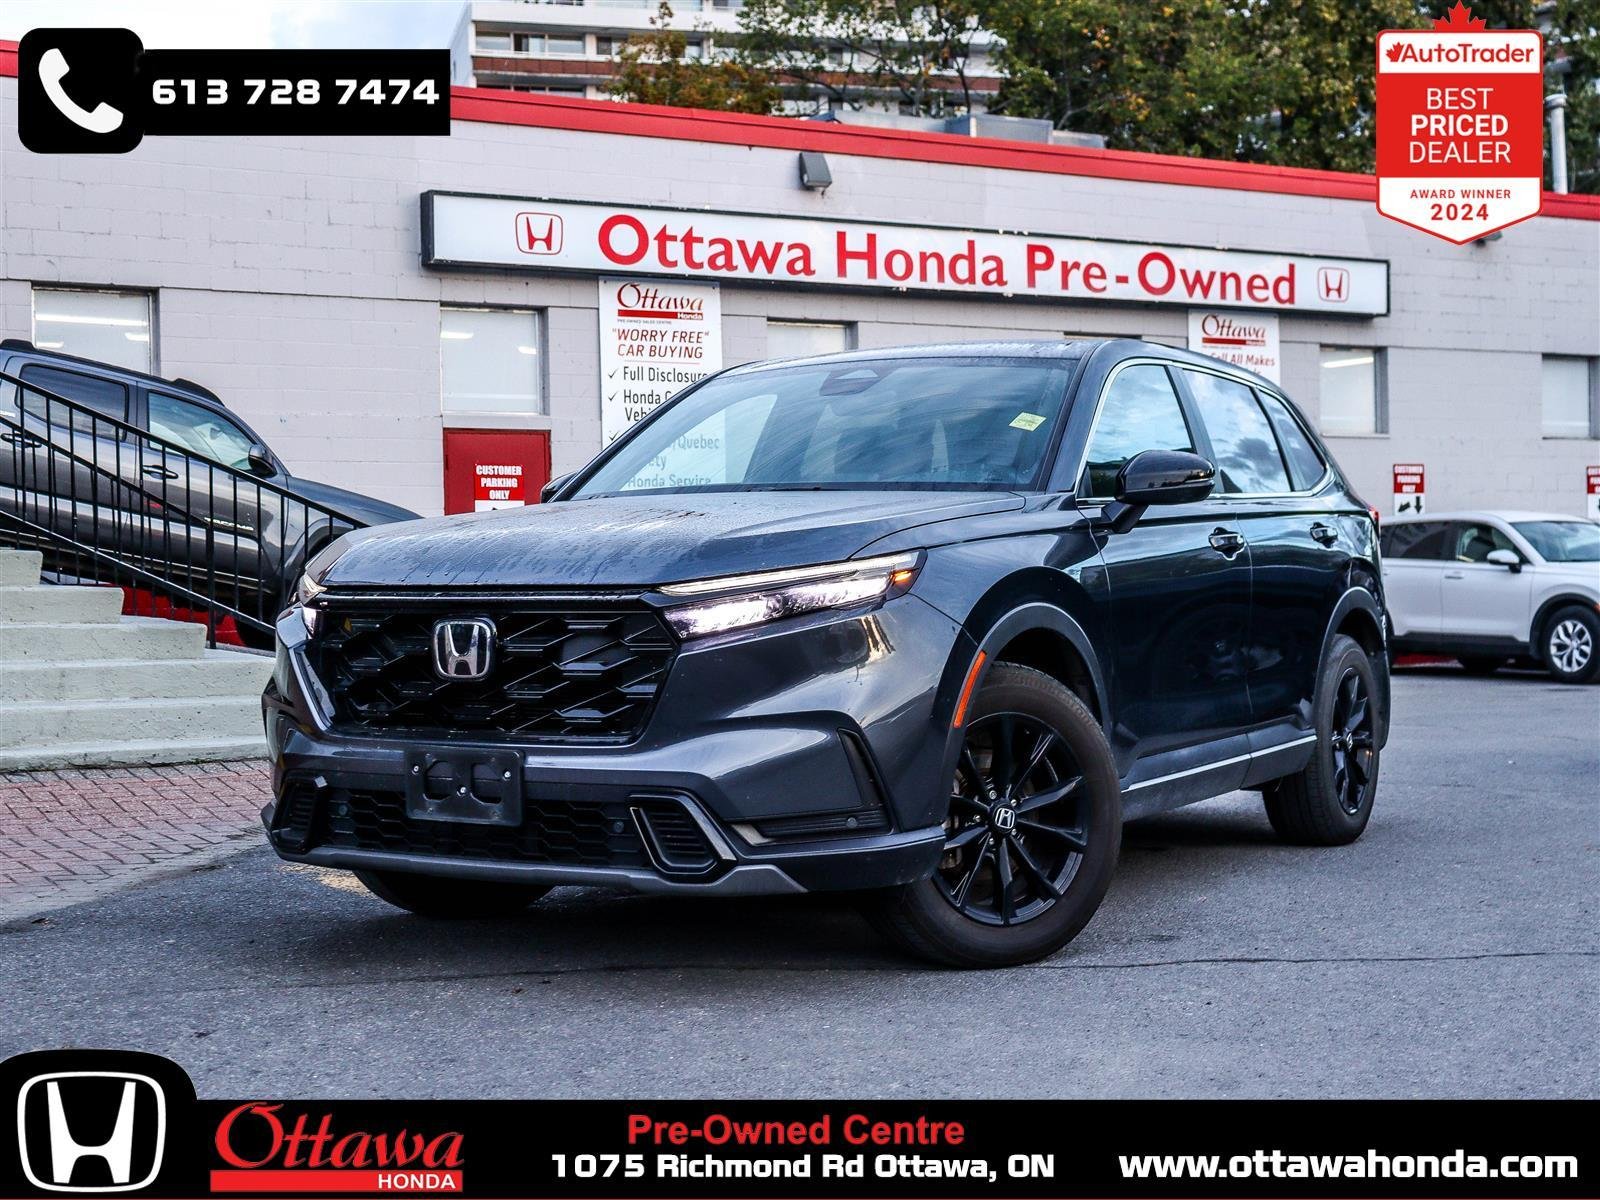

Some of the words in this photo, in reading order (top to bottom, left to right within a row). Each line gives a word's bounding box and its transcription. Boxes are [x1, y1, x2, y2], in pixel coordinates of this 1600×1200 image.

[597, 214, 815, 276] Ottawa
[836, 231, 1007, 287] Honda
[1026, 243, 1296, 304] Pre-Owned
[617, 282, 703, 310] Ottawa
[1201, 314, 1265, 338] Ottawa
[618, 344, 644, 357] CAR
[649, 345, 702, 359] BUYING
[1246, 355, 1275, 366] Makes
[623, 366, 644, 381] Full
[648, 367, 707, 384] Disclosur
[623, 389, 660, 405] Honda
[476, 465, 522, 476] CUSTOMER
[481, 478, 518, 488] PARKING
[489, 490, 510, 500] ONLY
